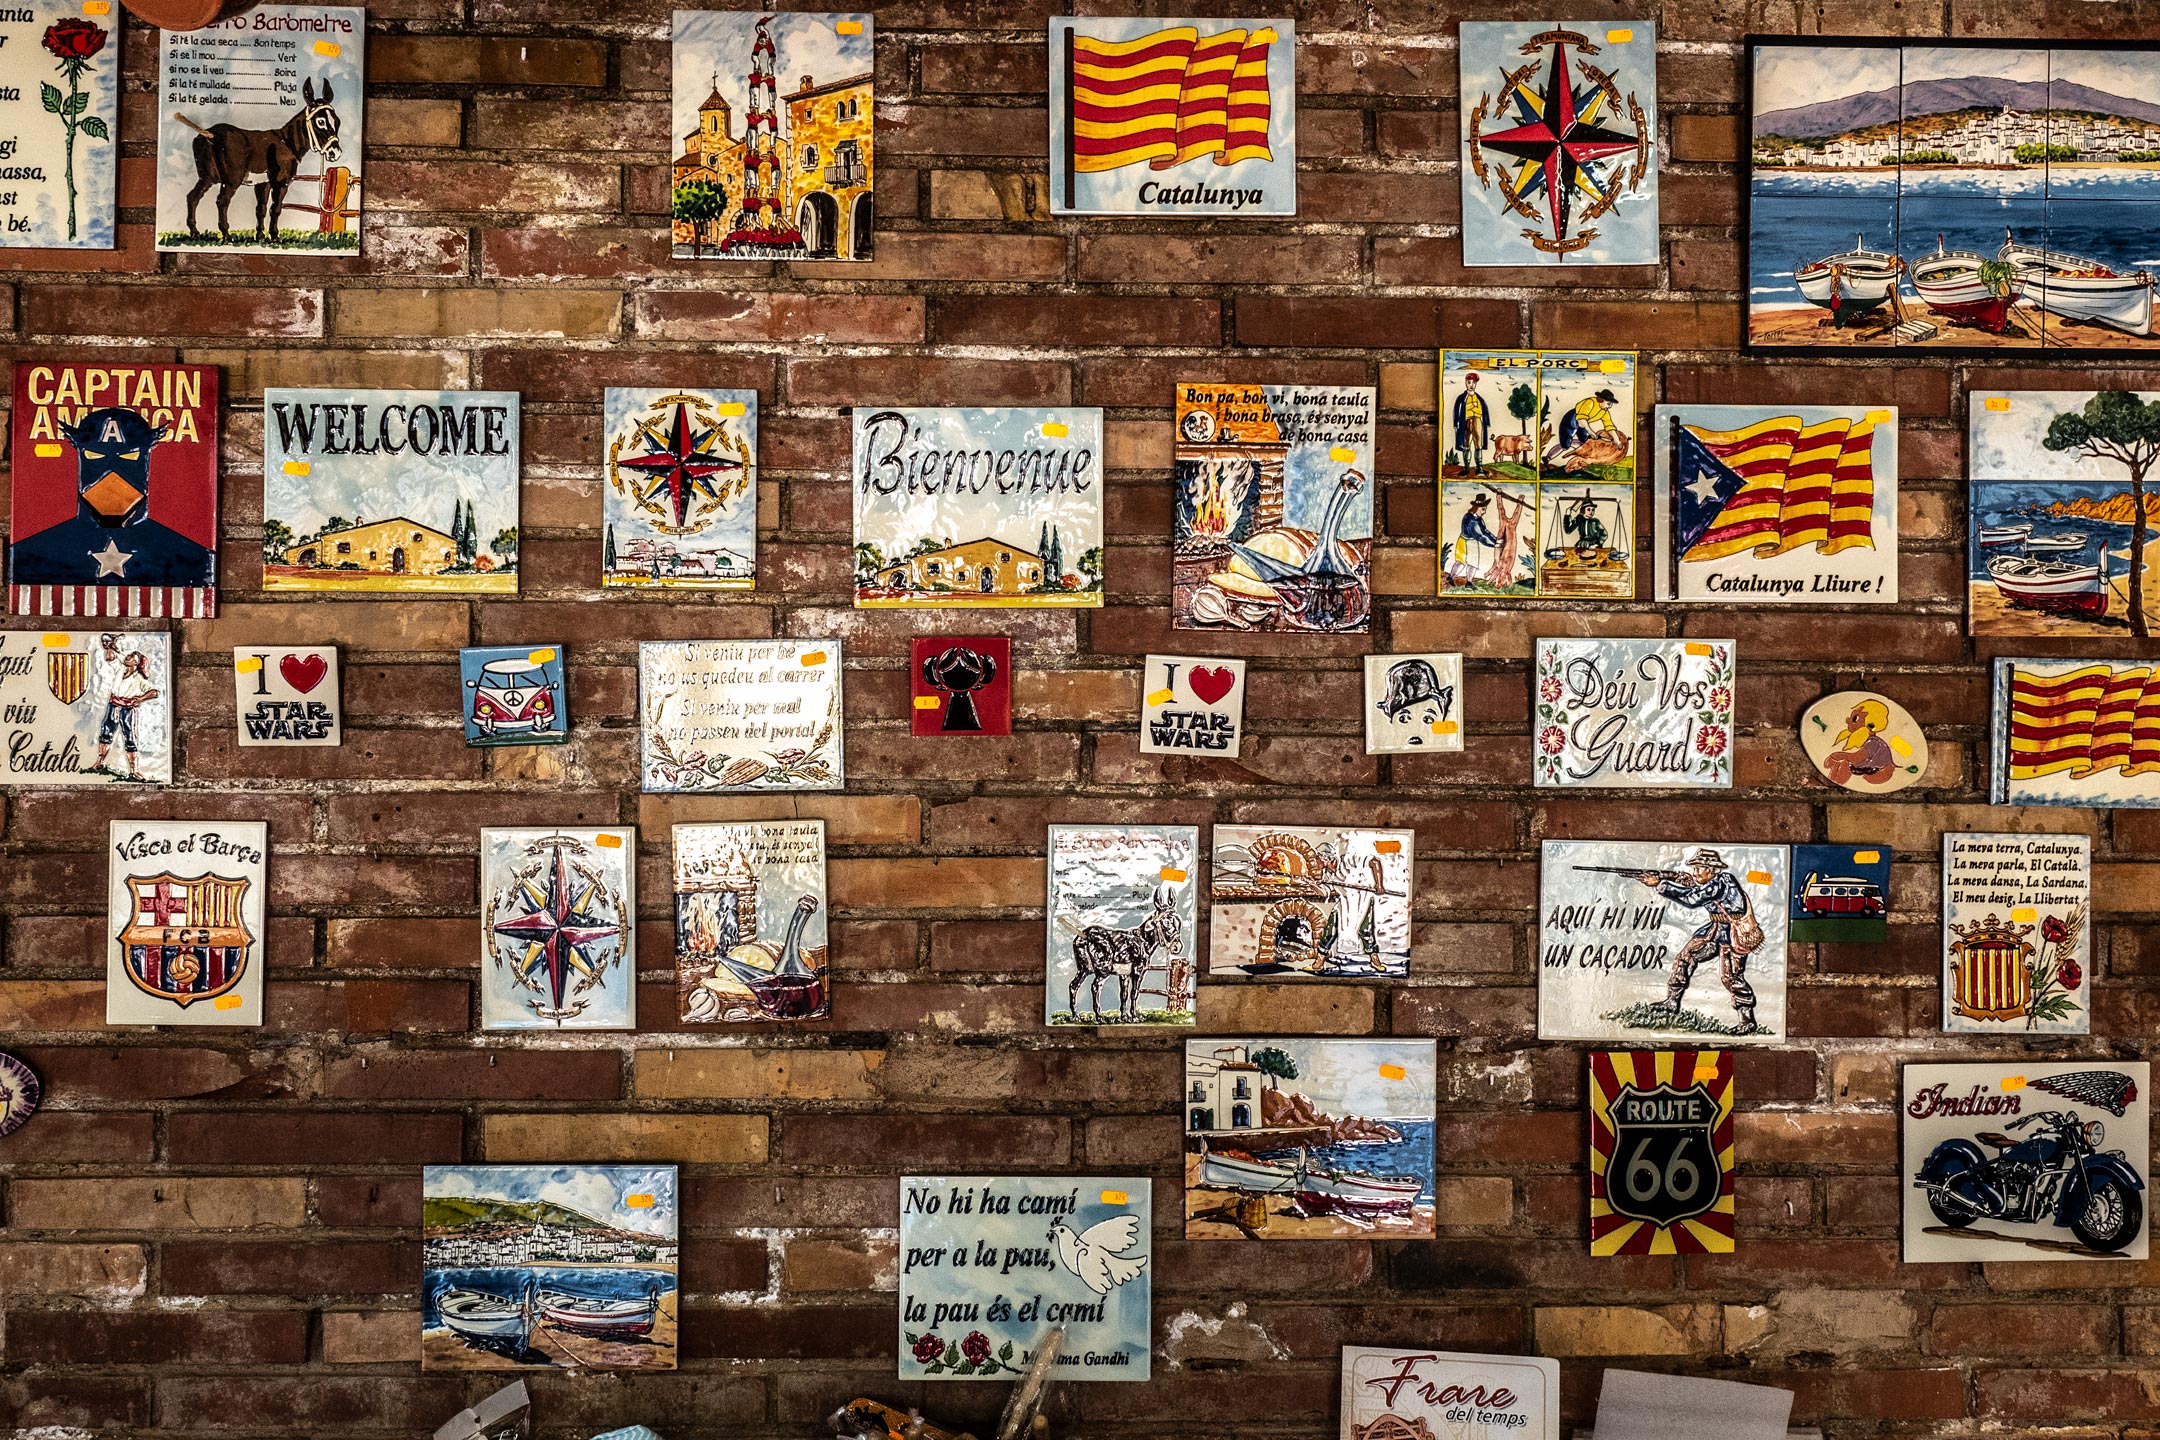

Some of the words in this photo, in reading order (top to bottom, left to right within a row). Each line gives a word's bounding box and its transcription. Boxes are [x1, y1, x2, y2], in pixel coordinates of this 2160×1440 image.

[252, 13, 353, 33] Baròmetre
[170, 35, 180, 46] Si
[181, 34, 189, 45] té
[190, 35, 199, 46] la
[200, 37, 216, 47] cua
[218, 38, 239, 47] seca
[169, 51, 179, 60] Si
[180, 52, 190, 61] se
[192, 50, 198, 60] li
[199, 53, 216, 61] mou
[277, 54, 298, 63] Vent
[178, 67, 189, 75] no
[190, 67, 201, 75] se
[202, 65, 208, 75] li
[209, 67, 225, 76] veu
[168, 79, 178, 89] Si
[179, 78, 188, 89] la
[188, 79, 198, 89] té
[199, 80, 231, 91] mullada
[274, 81, 297, 93] Pluja
[168, 94, 178, 103] Si
[178, 93, 187, 103] la
[187, 94, 198, 104] té
[199, 94, 229, 105] gelada
[279, 96, 297, 107] Neu
[0, 167, 47, 183] assa,
[1138, 181, 1264, 210] Catalunya
[8, 213, 32, 232] bé.
[1496, 358, 1519, 367] EL
[1525, 359, 1581, 368] PORC
[28, 366, 201, 408] CAPTAIN
[1186, 388, 1213, 403] Bon
[1216, 393, 1239, 408] pa,
[1242, 391, 1268, 405] bon
[1272, 393, 1289, 406] vi,
[1292, 391, 1328, 406] bona
[1331, 392, 1369, 407] taula
[272, 402, 509, 456] WELCOME
[1224, 408, 1259, 423] bona
[1261, 408, 1305, 426] brasa,
[1323, 410, 1369, 429] senyal
[102, 417, 126, 443] A
[1278, 428, 1295, 442] de
[1298, 428, 1333, 443] bona
[1337, 430, 1369, 443] casa
[860, 411, 1092, 496] Bienvenue
[1706, 573, 1805, 597] Catalunya
[1811, 574, 1872, 593] Lliure
[252, 654, 272, 695] I
[777, 669, 825, 684] carrer
[1162, 663, 1178, 704] I
[1566, 654, 1640, 711] Déu
[1637, 653, 1708, 711] Vos
[4, 697, 39, 724] viu
[245, 701, 333, 720] STAR
[743, 701, 770, 719] per
[1150, 710, 1231, 731] STAR
[246, 720, 333, 740] WARS
[745, 720, 768, 739] del
[771, 720, 816, 743] portal
[1150, 729, 1235, 749] WARS
[8, 729, 80, 773] Català
[1565, 713, 1694, 780] Guard
[115, 831, 173, 862] Visca
[177, 833, 196, 853] el
[199, 832, 262, 865] Barça
[1952, 841, 1965, 853] La
[1967, 843, 1994, 854] meva
[1996, 843, 2025, 855] terra,
[2027, 842, 2083, 859] Catalunya.
[1953, 857, 1967, 870] La
[1969, 860, 1995, 870] meva
[1997, 858, 2028, 874] parla,
[2030, 859, 2042, 871] El
[2043, 859, 2082, 872] Català.
[1947, 874, 1960, 886] La
[1962, 877, 1988, 887] meva
[1990, 875, 2025, 889] dansa,
[2026, 876, 2040, 888] La
[2042, 876, 2088, 889] Sardana.
[1952, 891, 1964, 903] El
[1966, 893, 1986, 904] meu
[1988, 891, 2017, 908] desig,
[2018, 892, 2031, 904] La
[2033, 892, 2080, 905] Llibertat
[1544, 897, 1602, 934] AQUÍ
[1543, 944, 1575, 969] UN
[1579, 944, 1668, 977] CAÇADOR
[1626, 1099, 1702, 1122] ROUTE
[1906, 1082, 2022, 1119] Indian
[1625, 1137, 1701, 1201] 66
[903, 1187, 941, 1214] No
[947, 1187, 973, 1214] hi
[978, 1187, 1011, 1214] ha
[1017, 1187, 1079, 1215] camí
[903, 1246, 948, 1274] per
[952, 1248, 968, 1267] a
[974, 1239, 998, 1267] la
[1000, 1248, 1057, 1274] pau,
[903, 1294, 927, 1323] la
[932, 1302, 979, 1330] pau
[986, 1294, 1011, 1323] és
[1017, 1294, 1042, 1323] el
[1046, 1295, 1108, 1323] camí
[1083, 1350, 1130, 1366] Gandhi
[1364, 1354, 1516, 1409] Frare
[1445, 1406, 1474, 1423] del
[1476, 1409, 1528, 1428] temps
